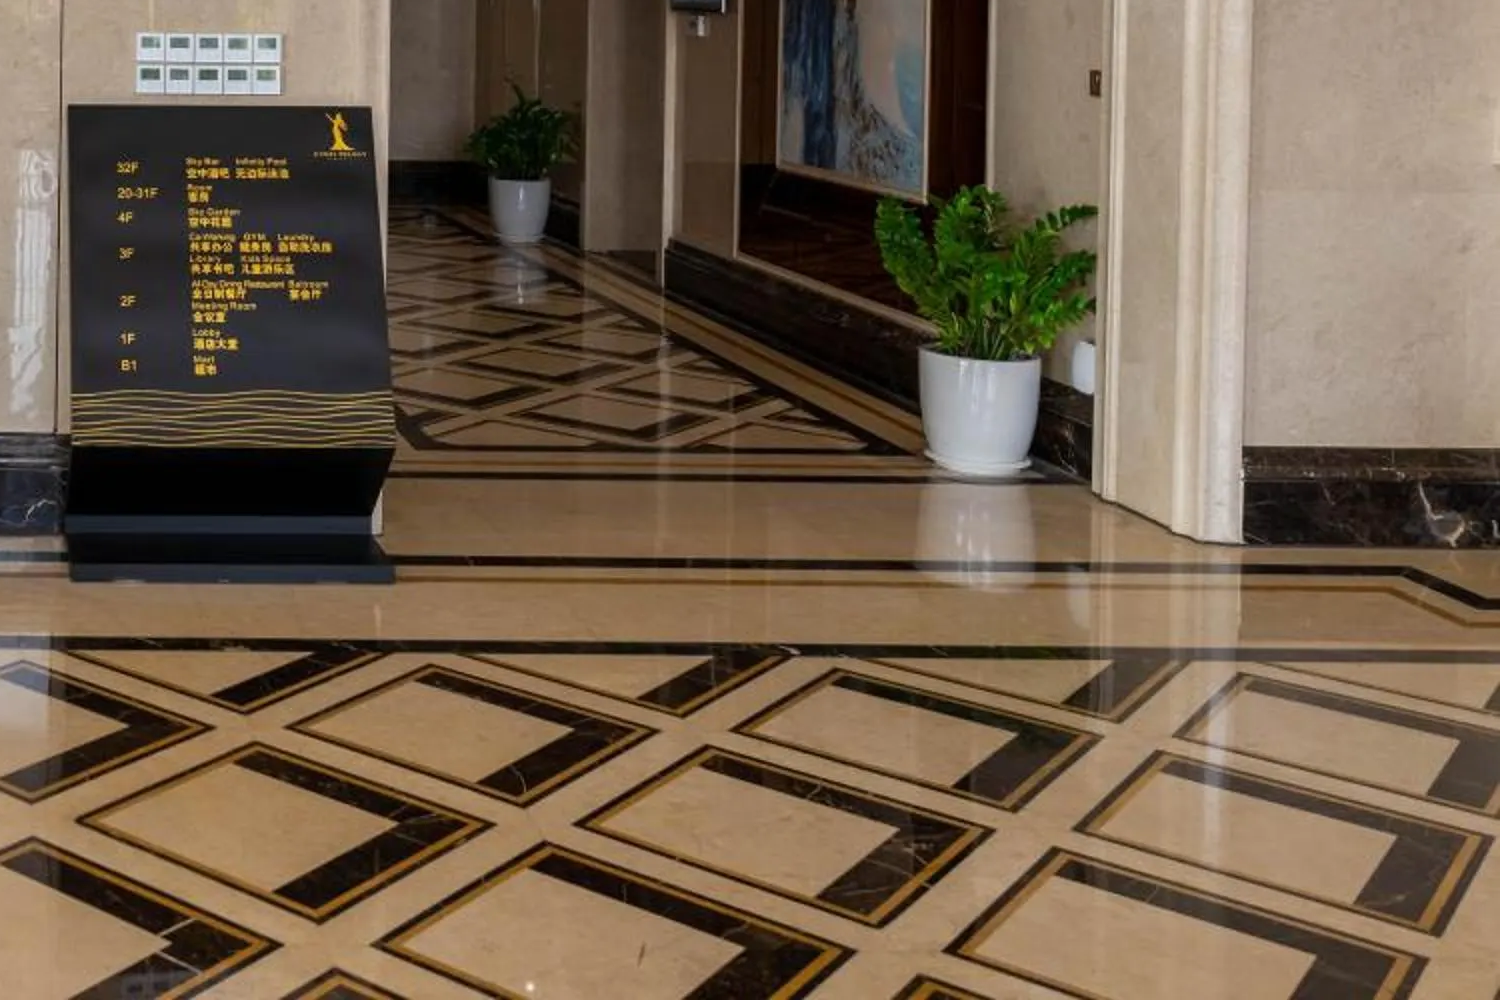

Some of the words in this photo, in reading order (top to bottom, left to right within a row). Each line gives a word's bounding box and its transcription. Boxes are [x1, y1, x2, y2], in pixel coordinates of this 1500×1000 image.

[116, 161, 139, 174] 32F
[117, 186, 159, 200] 20-31F
[117, 211, 133, 223] 4F
[119, 247, 134, 259] 3F
[119, 295, 136, 307] 2F
[120, 332, 136, 345] 1F
[192, 328, 220, 338] Lobby
[120, 359, 137, 372] B1
